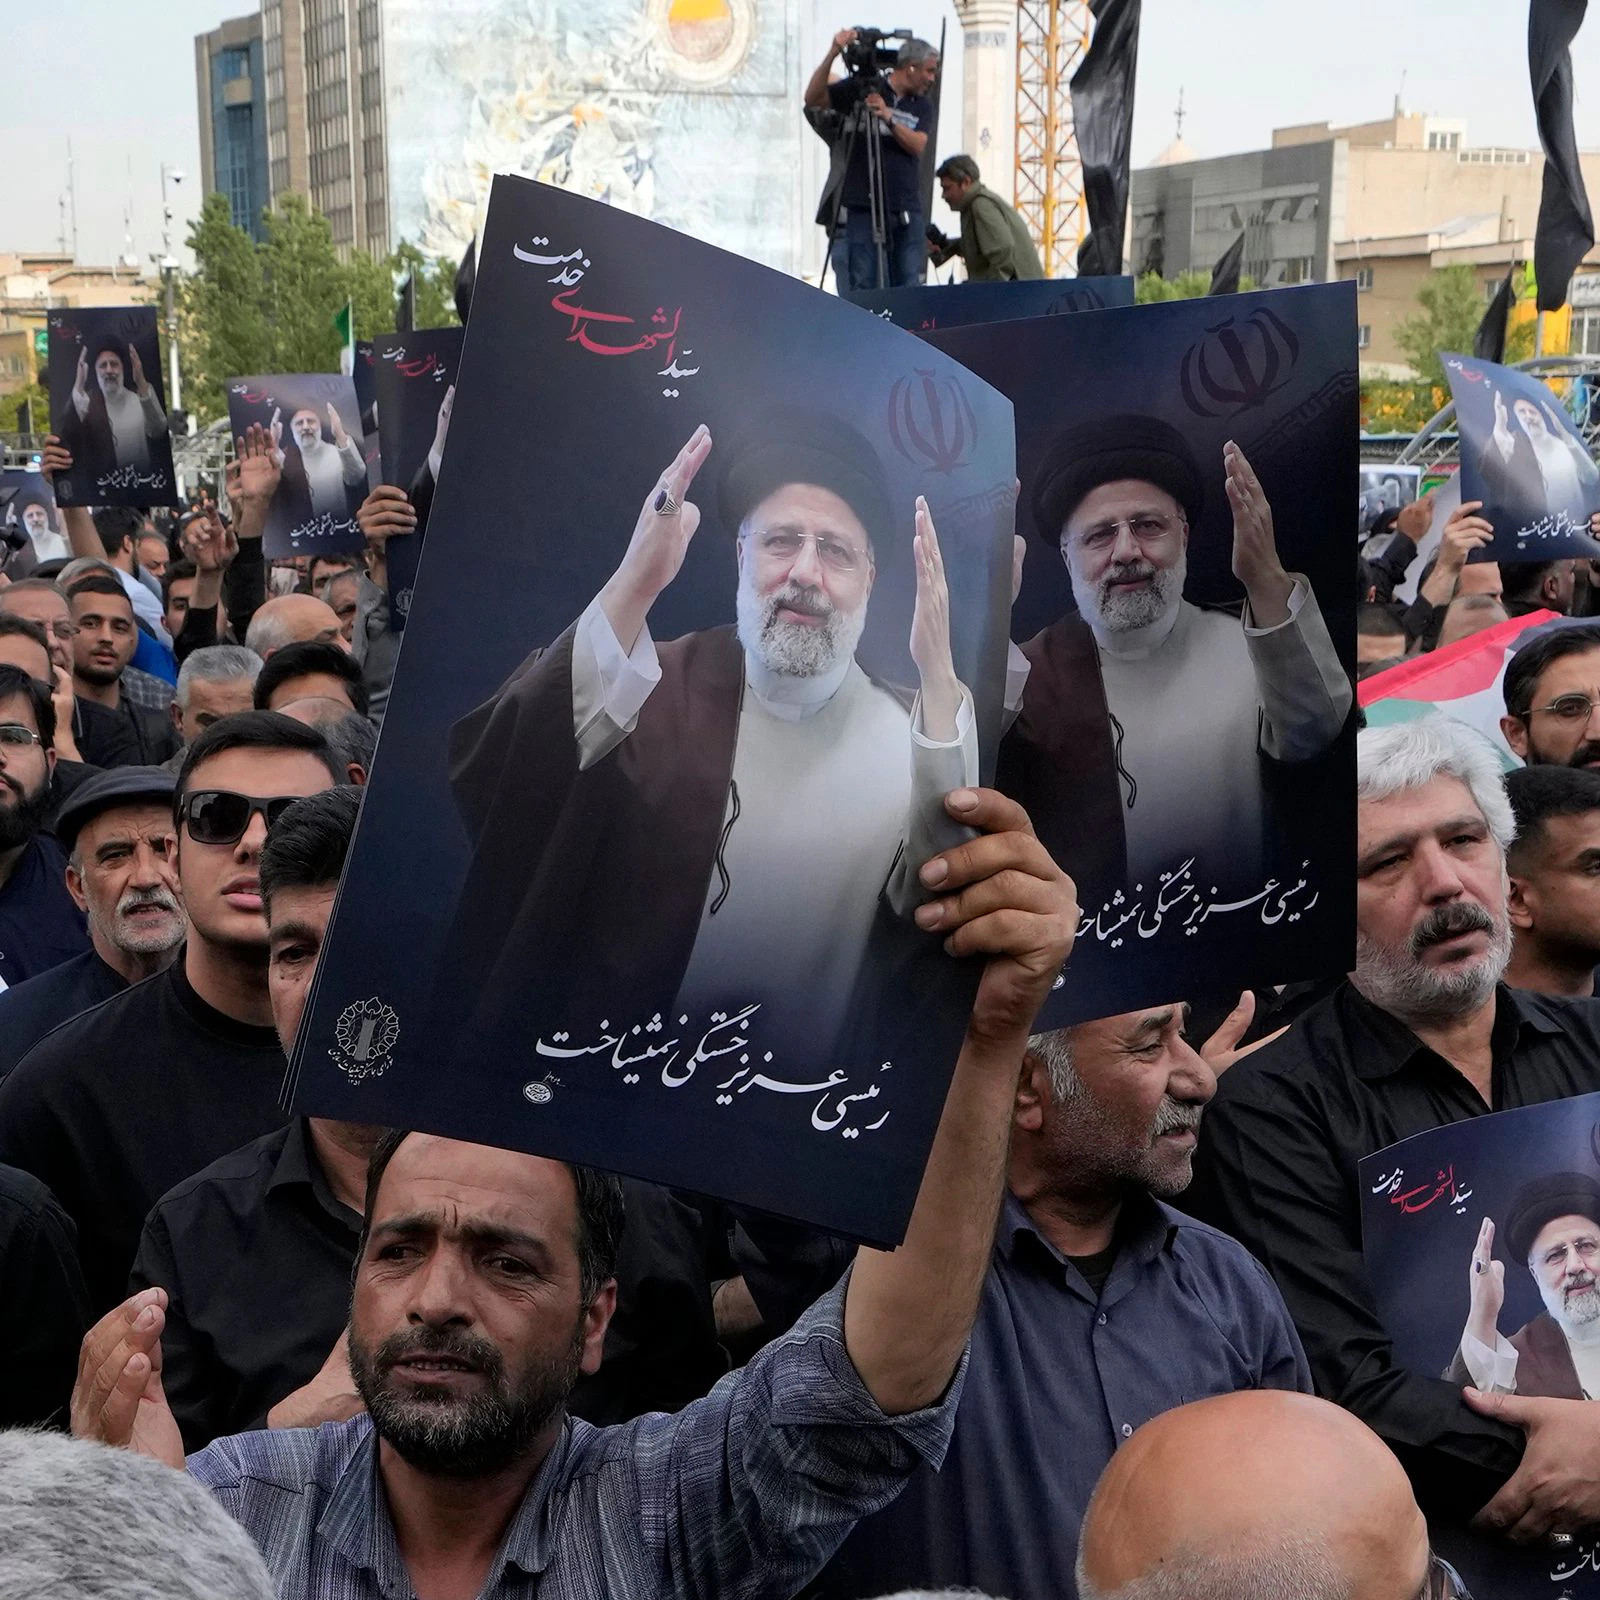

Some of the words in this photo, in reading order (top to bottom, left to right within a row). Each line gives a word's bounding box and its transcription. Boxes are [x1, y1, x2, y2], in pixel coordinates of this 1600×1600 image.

[513, 236, 591, 286] خدمت
[1075, 883, 1143, 949] نمیشناخ
[1137, 857, 1195, 938] خستگی
[1183, 878, 1280, 937] عزیز
[1261, 859, 1319, 925] رئیسی
[661, 1003, 762, 1088] خستگی
[716, 1050, 848, 1105] عزیز
[811, 1061, 893, 1139] رئیسی
[1372, 1167, 1404, 1195] خدمت
